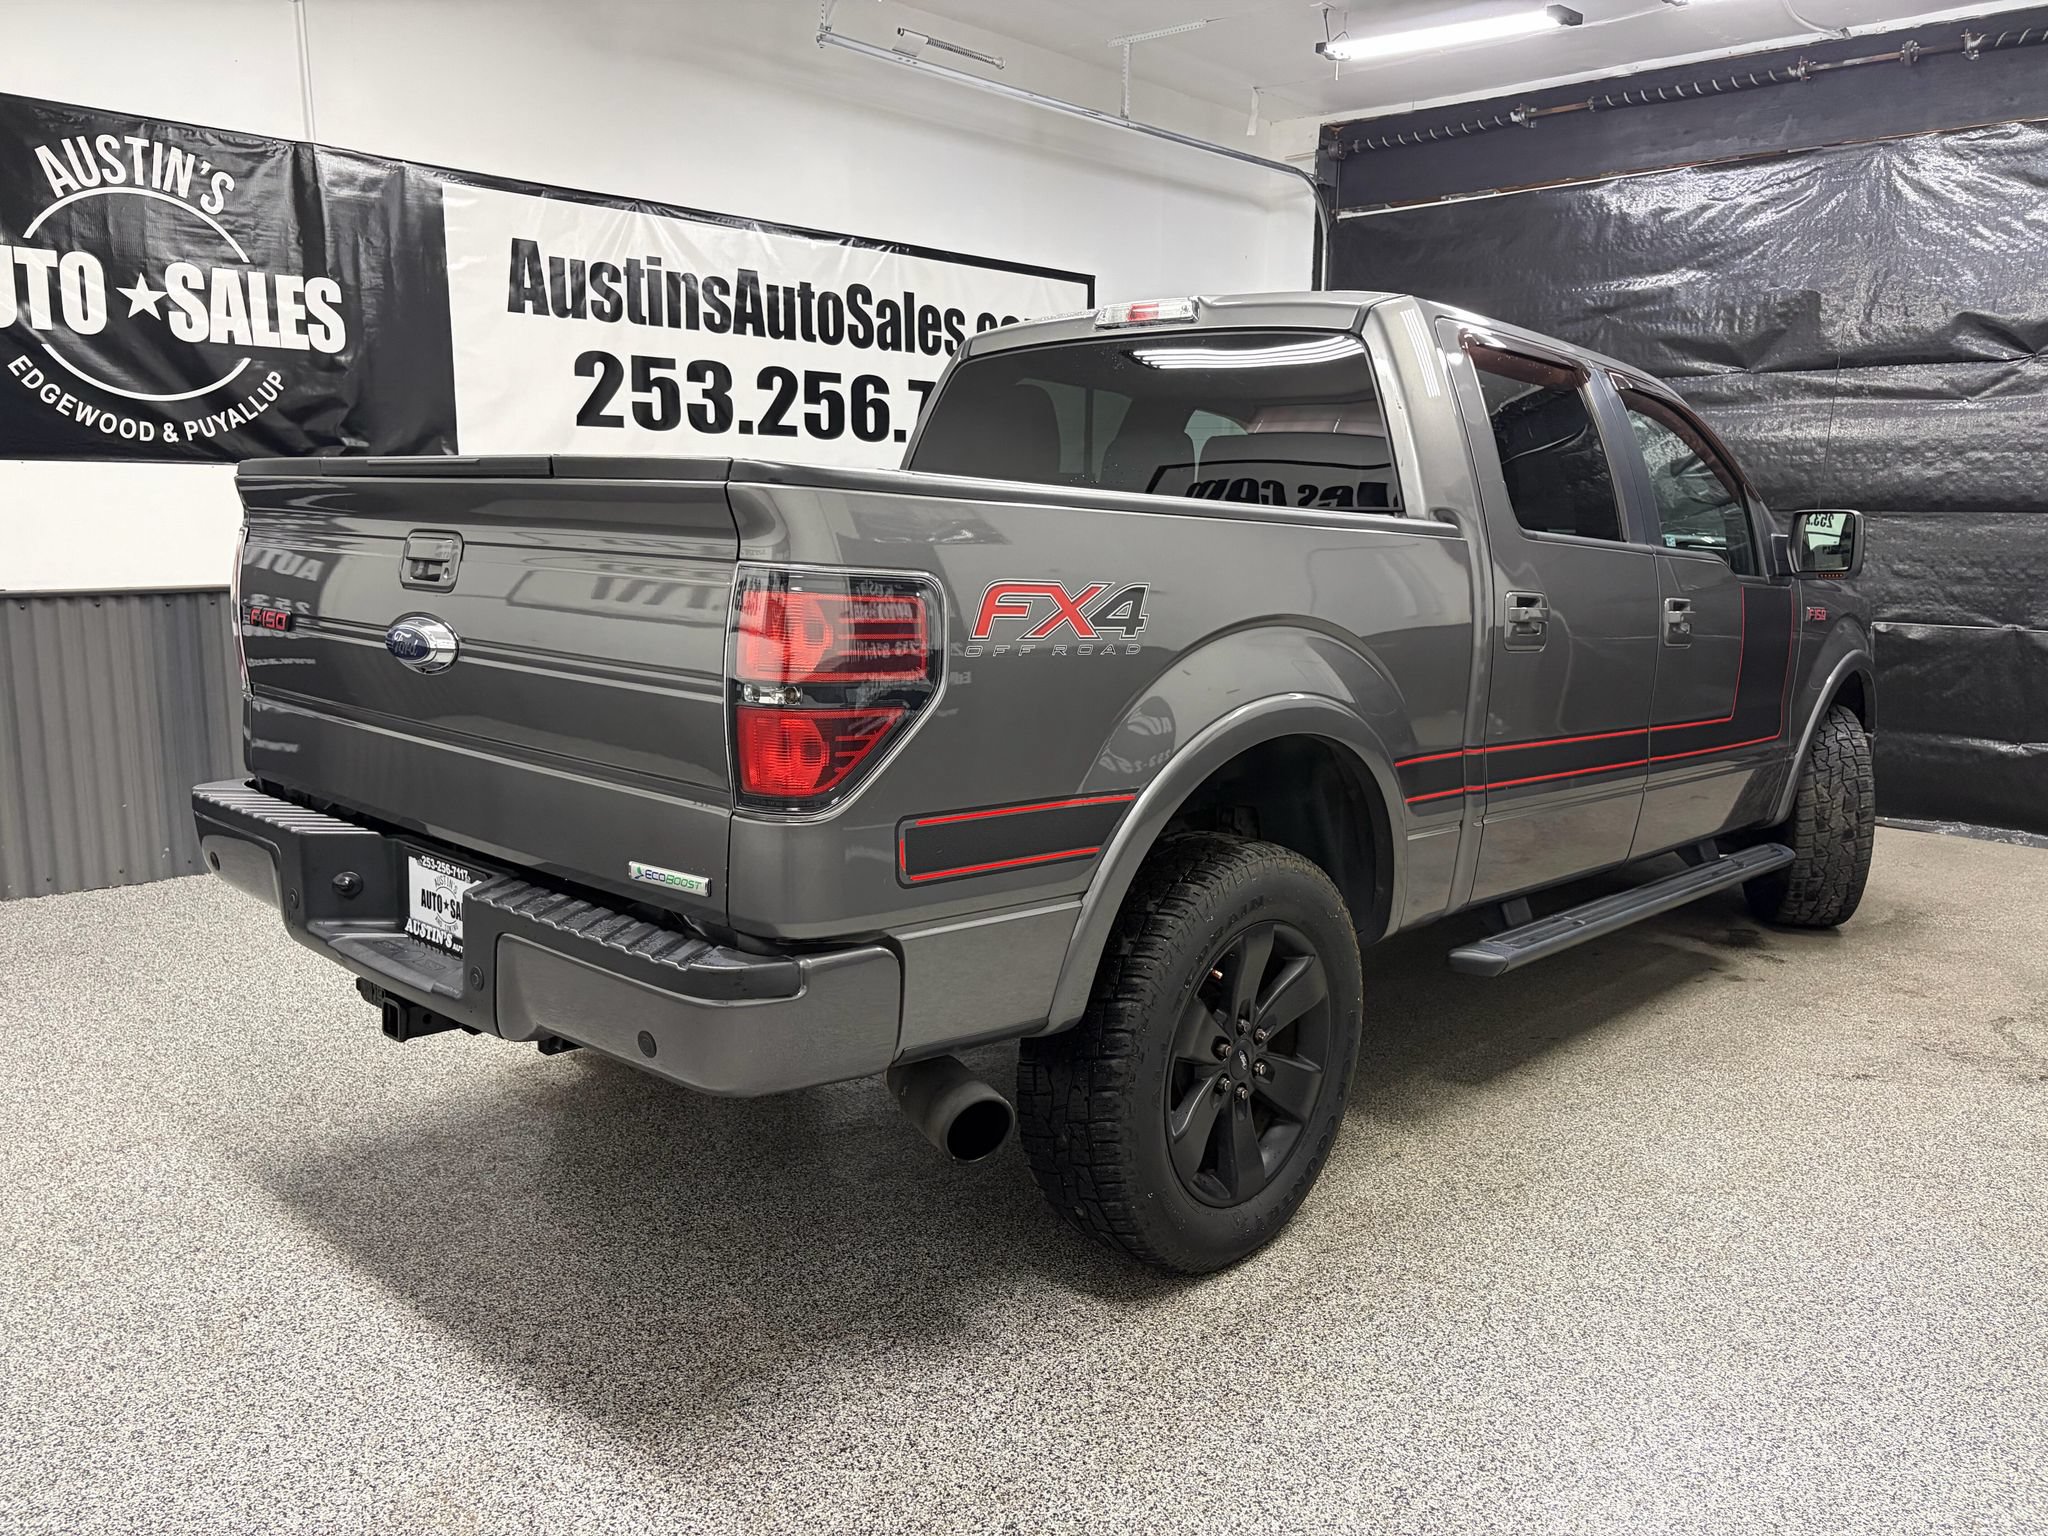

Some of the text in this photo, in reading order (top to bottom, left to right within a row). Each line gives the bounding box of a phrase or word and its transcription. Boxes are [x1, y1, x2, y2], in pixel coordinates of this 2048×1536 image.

[34, 134, 236, 215] AUSTIN'S
[165, 262, 347, 354] SALES
[506, 237, 1032, 357] AustinsAutoSales
[7, 354, 286, 443] EDGEWOOD & PUYALLUP
[968, 578, 1151, 642] FX4
[393, 630, 418, 656] Ford
[965, 643, 1142, 657] OFF ROAD
[421, 888, 442, 914] AUTO
[645, 869, 703, 890] ECOBOOST
[404, 918, 453, 948] AUSTIN'S
